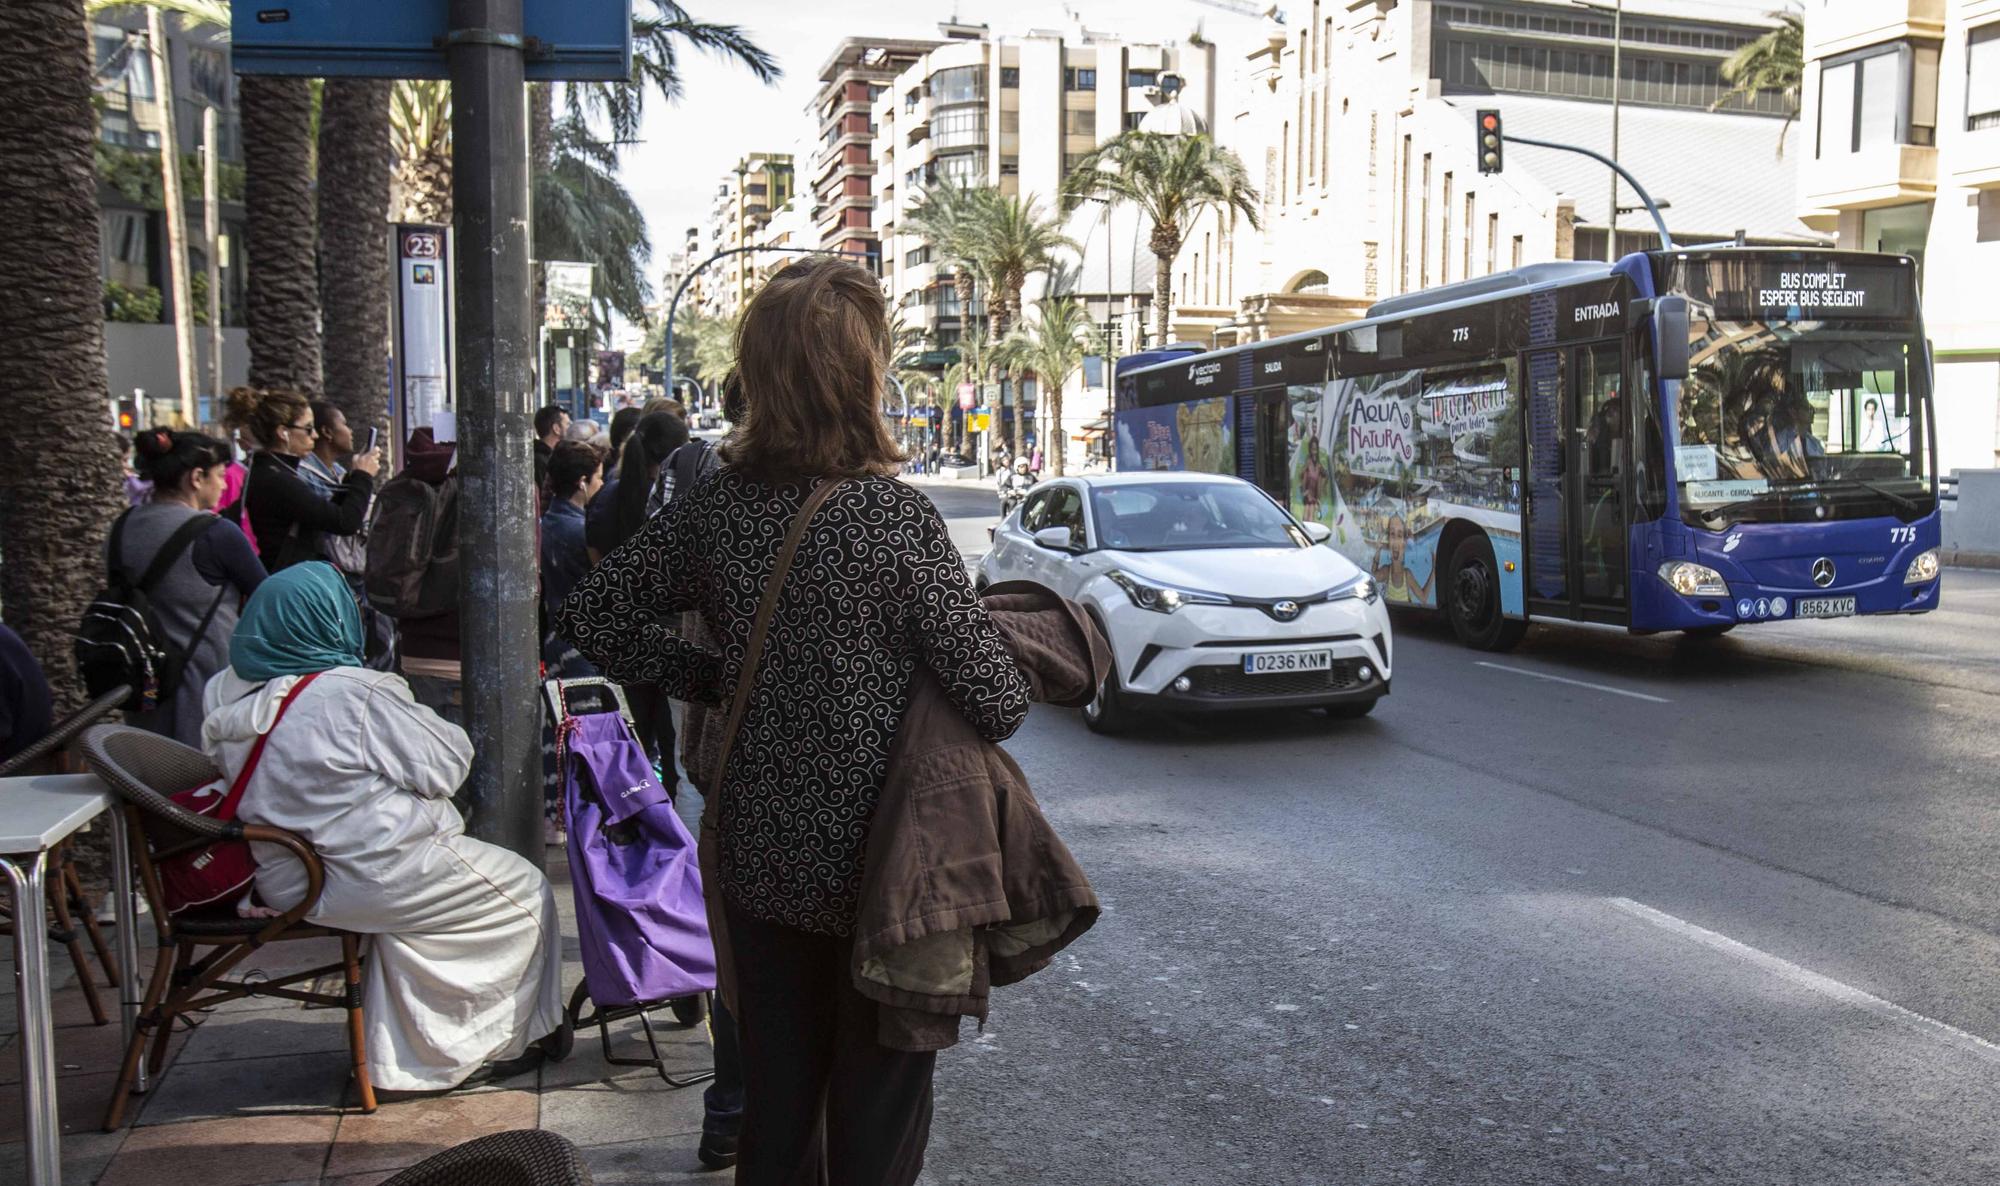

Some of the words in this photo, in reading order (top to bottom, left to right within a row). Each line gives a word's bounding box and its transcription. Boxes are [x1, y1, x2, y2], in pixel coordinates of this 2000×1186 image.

[411, 237, 435, 255] 23
[1781, 273, 1800, 288] BUS
[1802, 273, 1846, 289] COMPLET
[1760, 290, 1798, 306] ESPERE
[1800, 291, 1819, 306] BUS
[1574, 302, 1620, 322] ENTRADA
[1452, 327, 1469, 342] 775
[1264, 361, 1282, 373] SALIDA
[1351, 397, 1411, 430] AQUA
[1350, 426, 1413, 461] NATURA
[1891, 527, 1916, 543] 775
[1802, 600, 1830, 614] 8562
[1833, 597, 1854, 613] KVC
[1256, 654, 1296, 671] 0236
[1299, 653, 1328, 669] KNW
